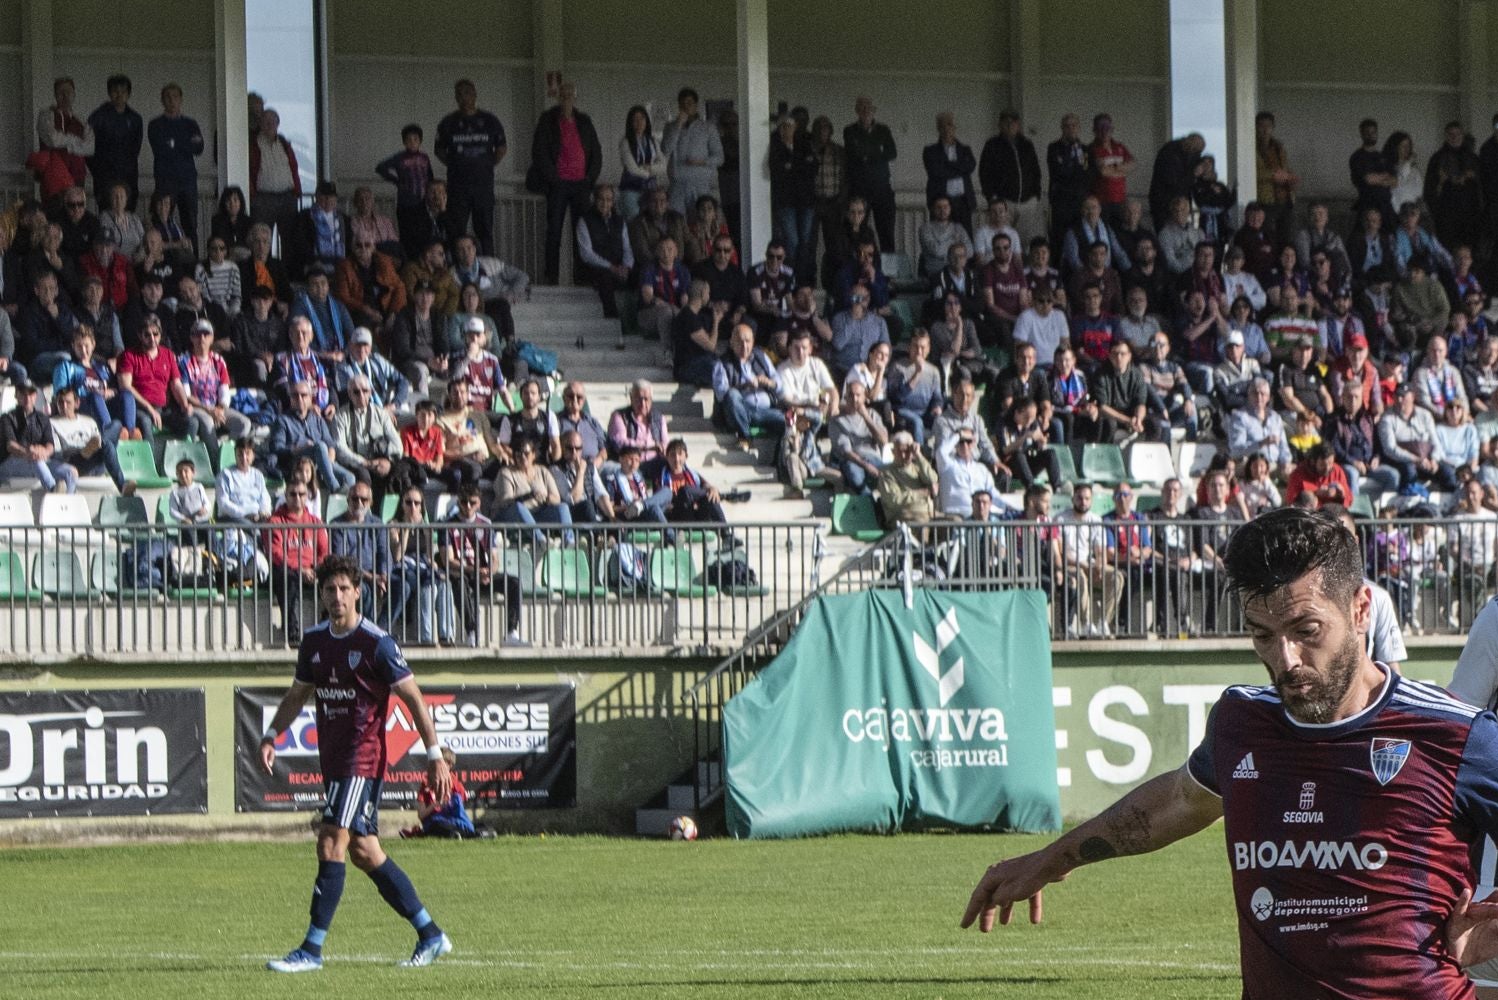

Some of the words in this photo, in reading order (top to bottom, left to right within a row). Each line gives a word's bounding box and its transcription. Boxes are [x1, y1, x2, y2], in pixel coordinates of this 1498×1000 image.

[842, 698, 1008, 752] cajaviva
[444, 736, 521, 749] SOLUCIONES
[911, 744, 1008, 771] cajarural
[1232, 770, 1260, 779] adidas
[0, 784, 168, 801] EGURIDAD
[1283, 811, 1324, 823] SEGOVIA
[1234, 840, 1388, 870] BIOAMMO
